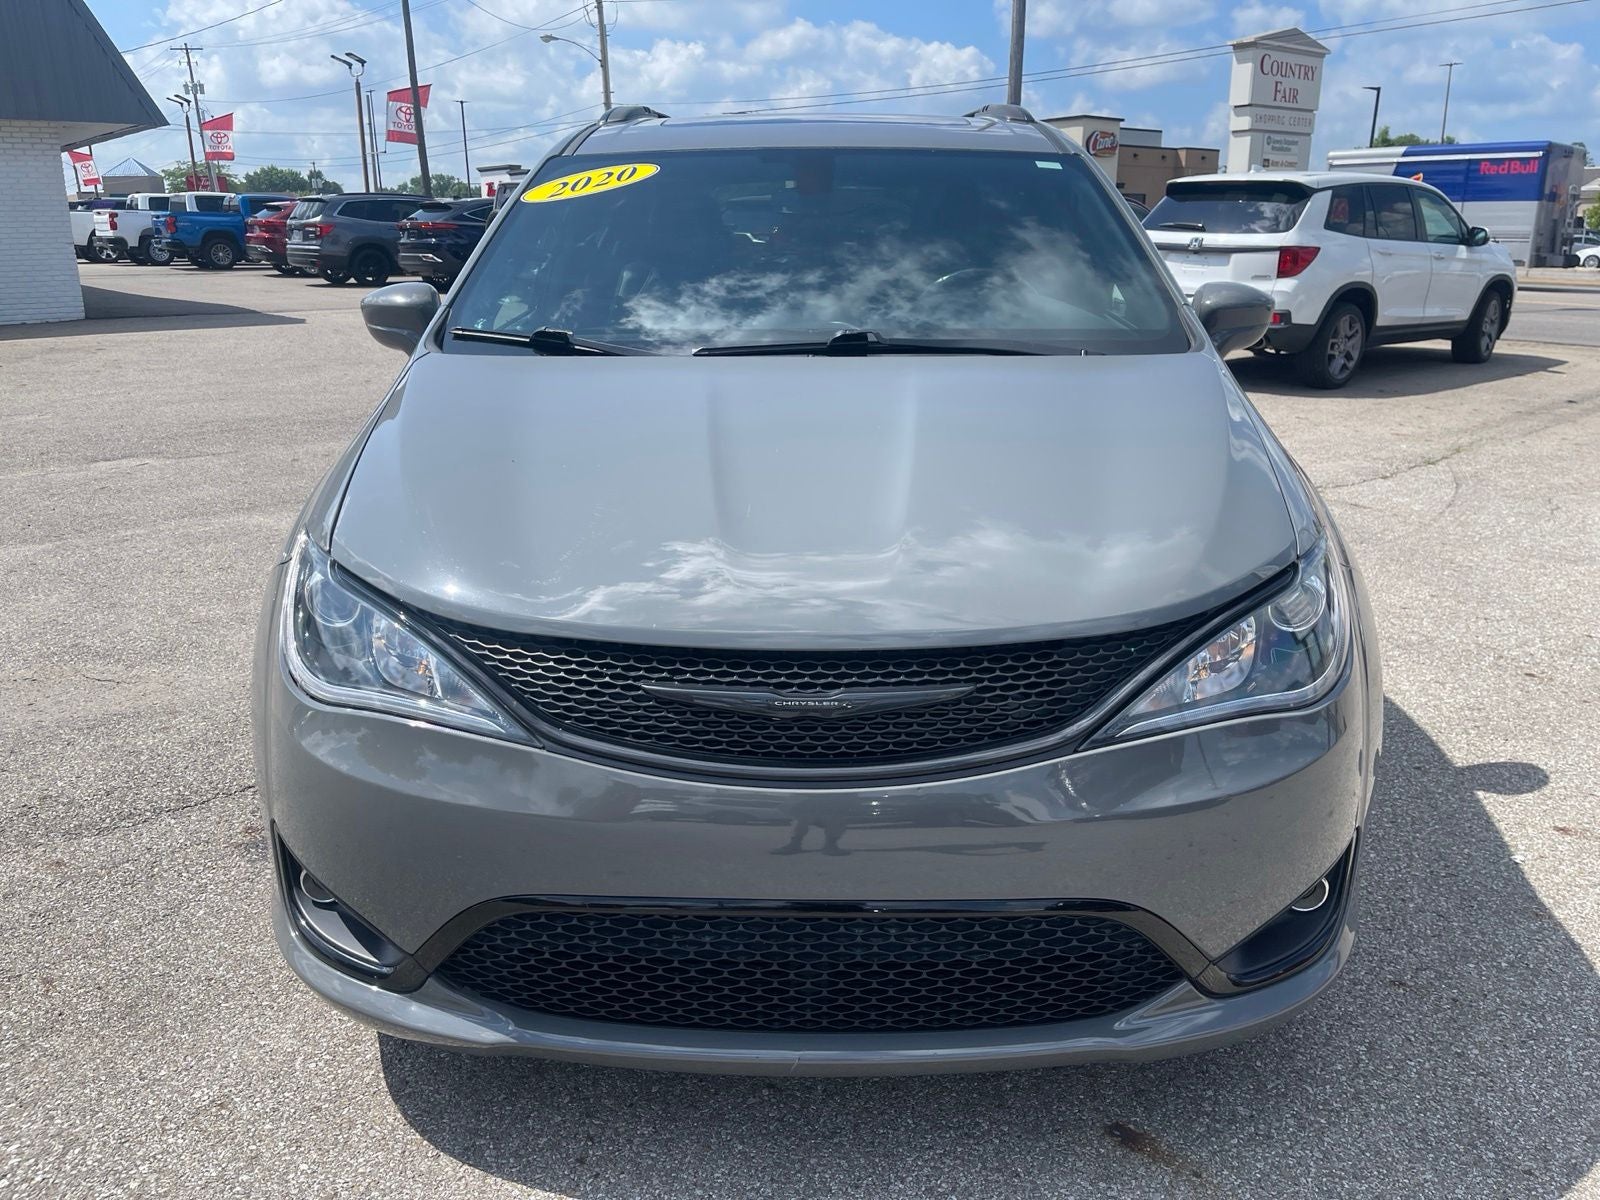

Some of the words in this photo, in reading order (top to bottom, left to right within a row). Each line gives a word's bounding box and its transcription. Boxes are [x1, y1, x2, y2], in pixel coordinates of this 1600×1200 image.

[1260, 53, 1317, 81] COUNTRY
[1273, 81, 1299, 104] FAIR
[392, 121, 414, 131] TOYO
[1255, 113, 1285, 125] SHOPPING
[1288, 116, 1312, 127] CENTER
[1479, 161, 1508, 175] Red
[1510, 160, 1538, 174] Bull
[547, 166, 638, 199] 2020
